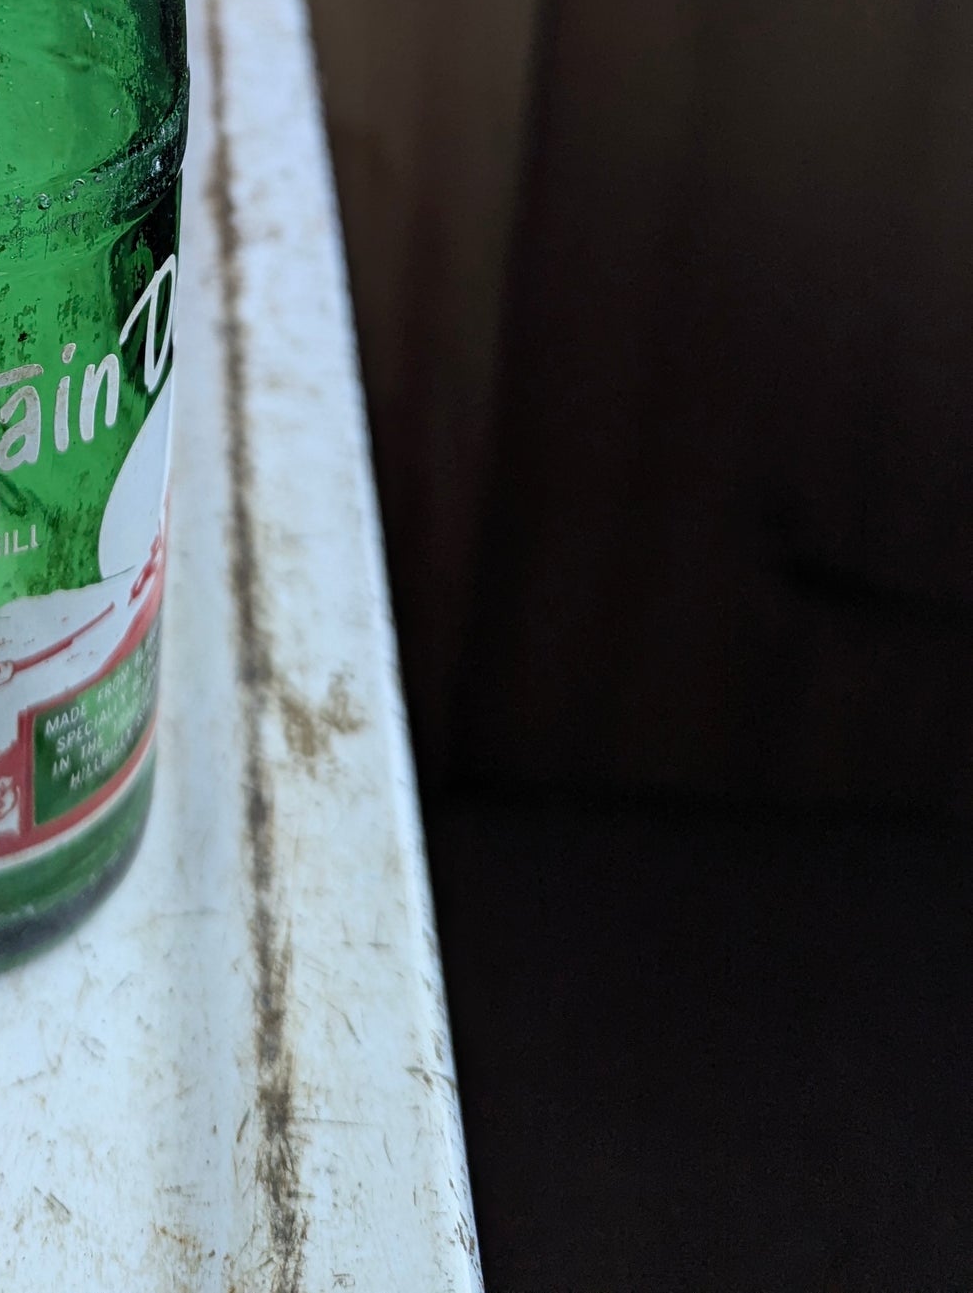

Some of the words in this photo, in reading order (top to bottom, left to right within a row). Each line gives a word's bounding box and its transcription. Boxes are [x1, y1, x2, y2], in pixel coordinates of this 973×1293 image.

[44, 702, 87, 736] MADE
[97, 665, 130, 701] FROM
[52, 754, 70, 776] IN
[80, 735, 104, 759] THE
